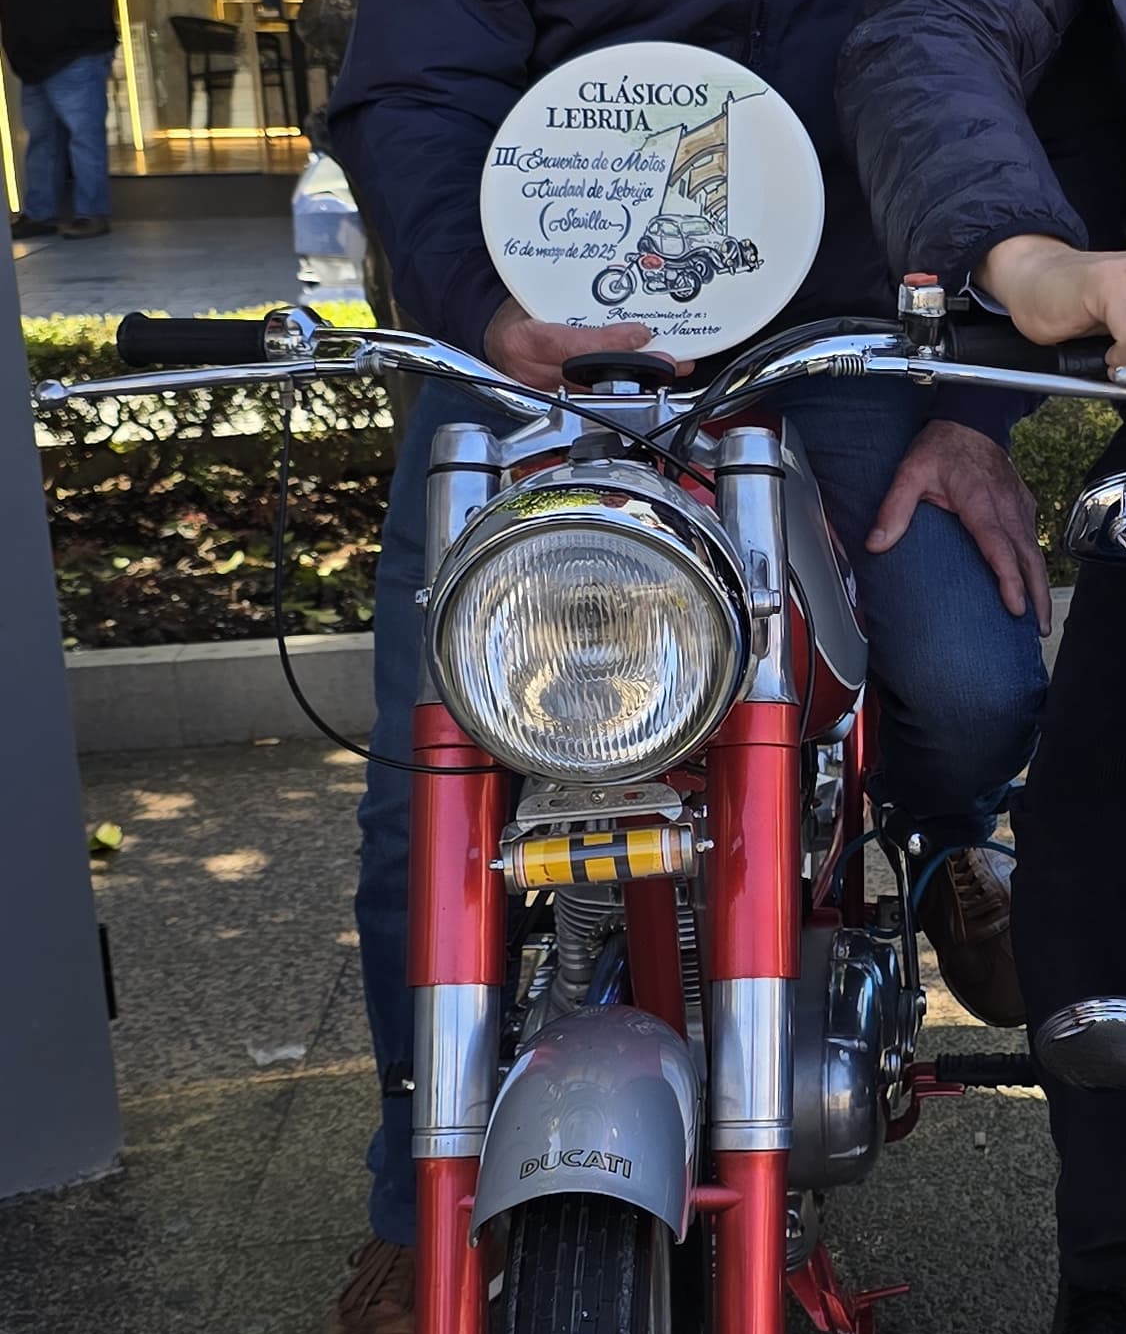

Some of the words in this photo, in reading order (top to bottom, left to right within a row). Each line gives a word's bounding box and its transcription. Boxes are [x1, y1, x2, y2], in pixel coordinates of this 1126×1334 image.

[578, 75, 709, 107] CLÁSICOS
[546, 106, 653, 133] LEBRIJA
[491, 146, 522, 167] III
[517, 147, 589, 172] Encuentro
[591, 151, 609, 170] de
[611, 151, 666, 172] Motos
[522, 178, 585, 199] Ciudad
[586, 180, 603, 199] de
[605, 178, 654, 206] Lebrija
[503, 238, 519, 257] 16
[519, 241, 536, 257] de
[536, 246, 565, 264] marzo
[565, 243, 580, 259] de
[579, 243, 619, 261] 2025
[606, 307, 692, 320] Reconocimiento
[664, 320, 722, 336] Navarro
[519, 1149, 633, 1180] DUCATI
